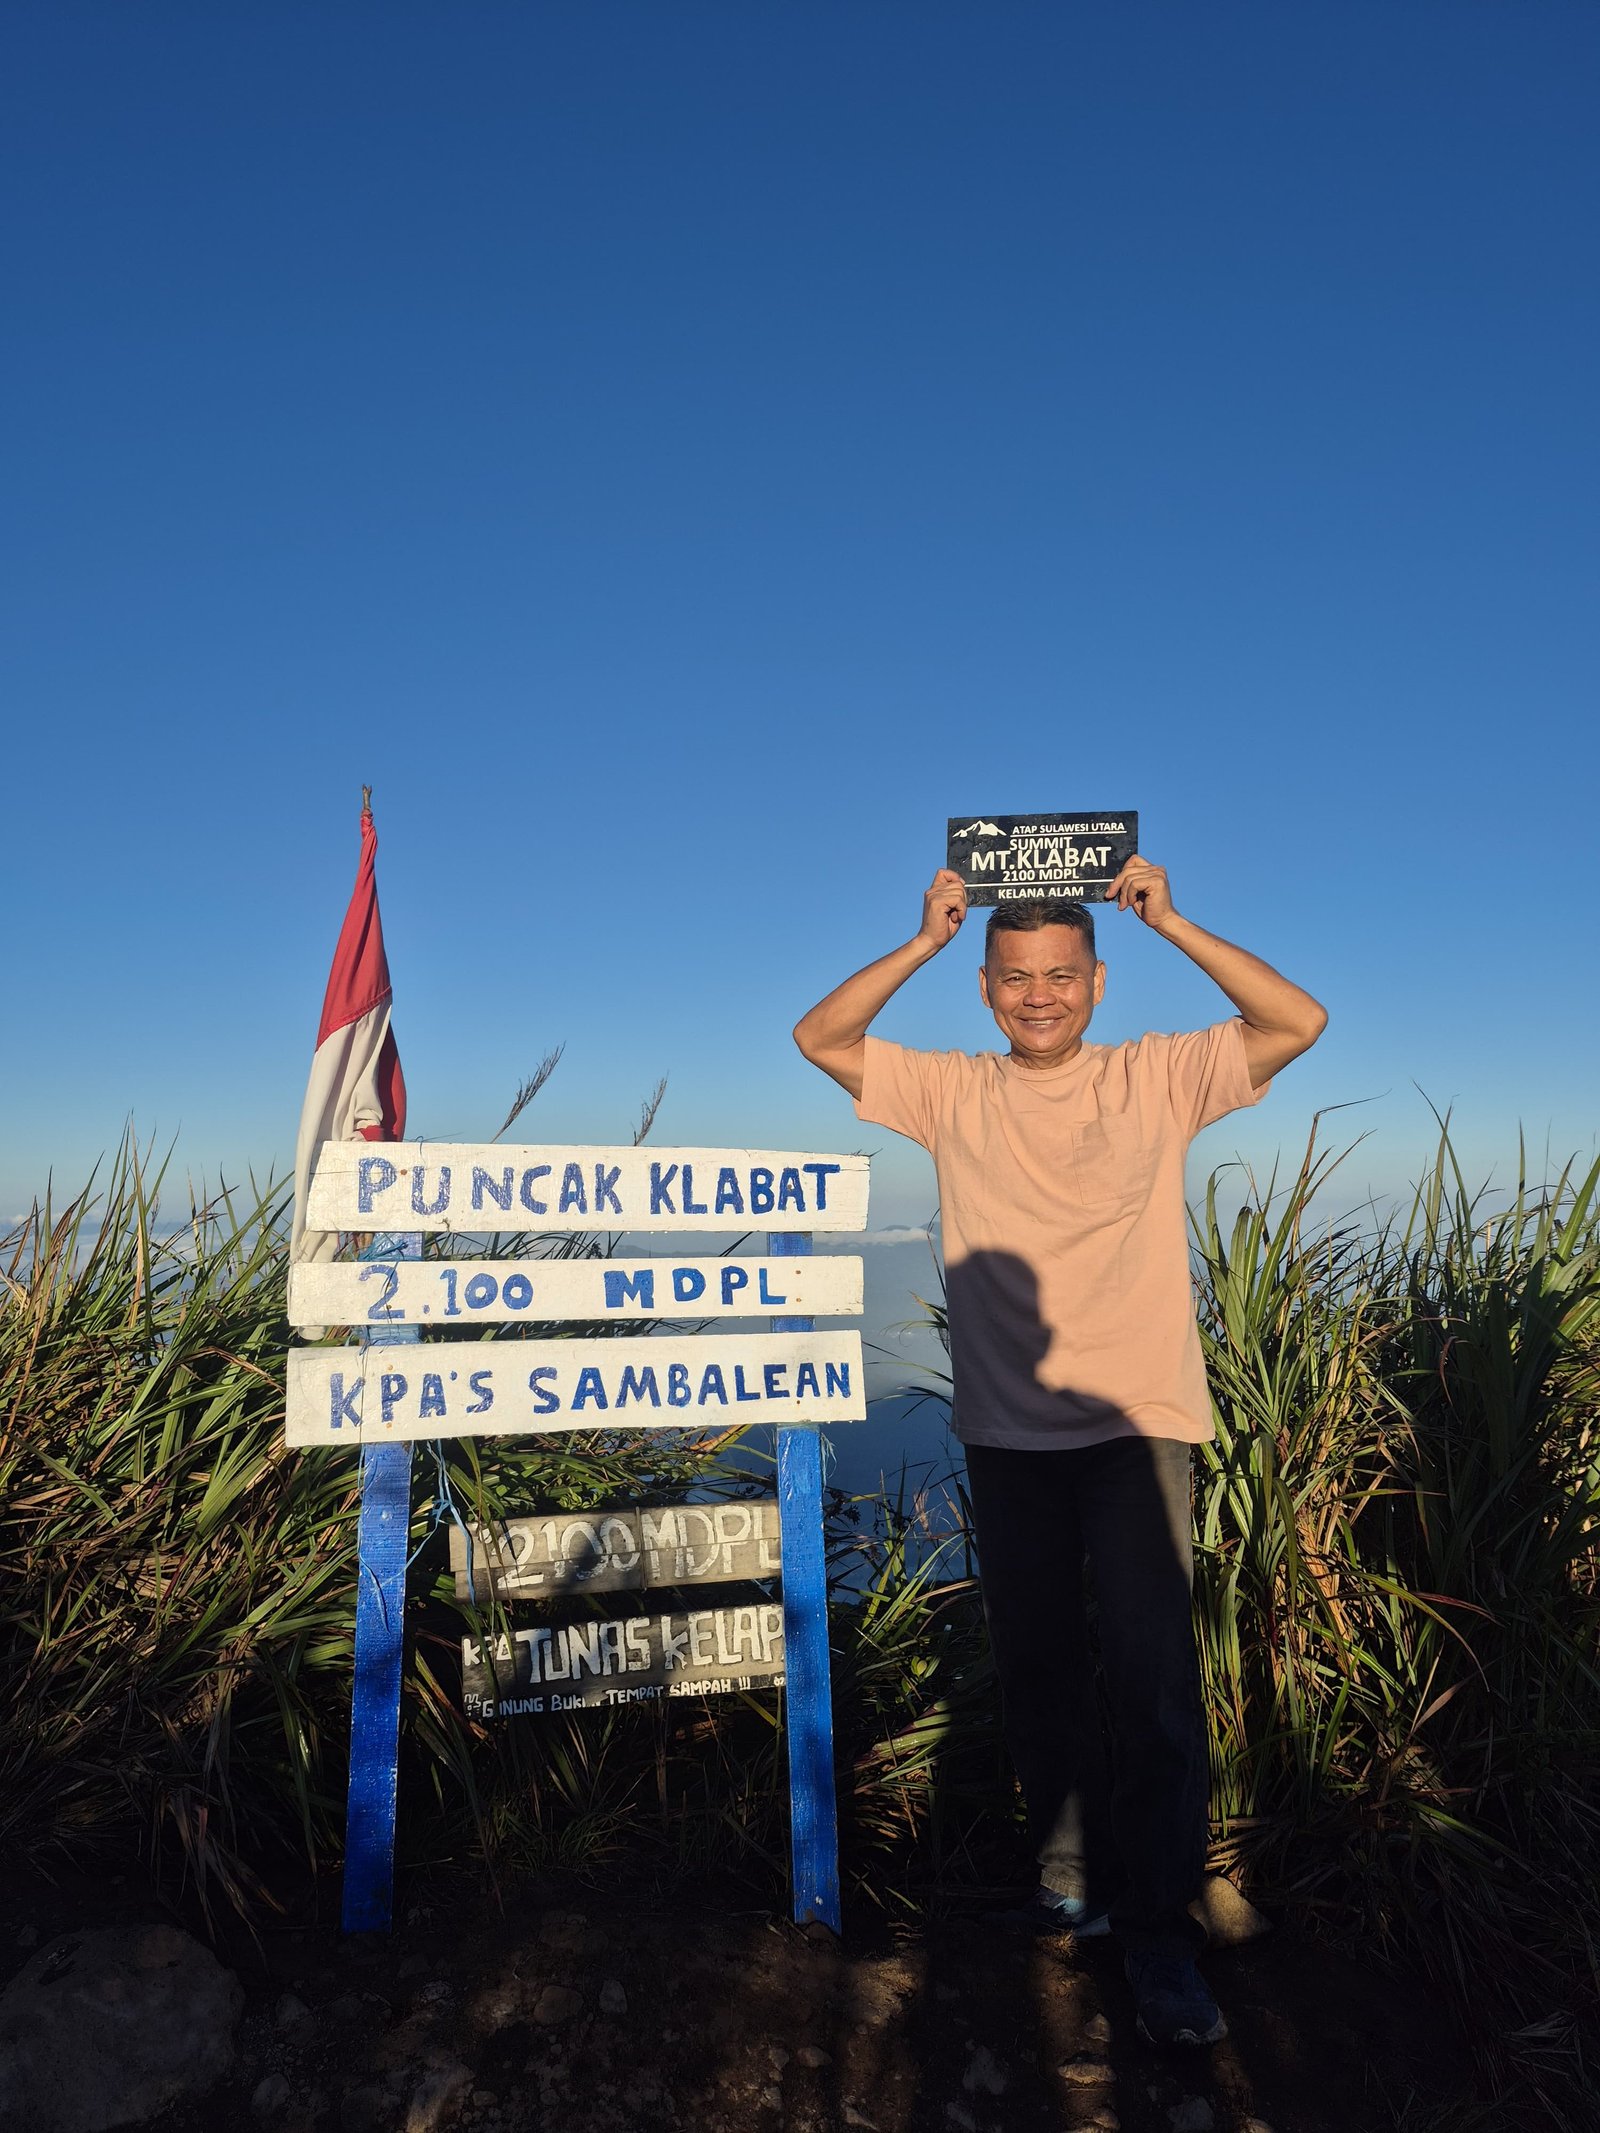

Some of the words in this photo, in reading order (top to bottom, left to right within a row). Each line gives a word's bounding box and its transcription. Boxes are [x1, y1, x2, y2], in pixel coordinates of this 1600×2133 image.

[1012, 825, 1037, 835] ATAP
[1039, 823, 1089, 834] SULAWESI
[1091, 822, 1125, 832] UTARA
[1009, 836, 1073, 851] SUMMIT
[971, 846, 1112, 871] MT.KLABAT
[1002, 869, 1037, 882] 2100
[1039, 868, 1080, 881] MDPL
[998, 887, 1046, 900] KELANA
[1048, 886, 1084, 898] ALAM
[357, 1156, 623, 1216] PUNCAK
[649, 1162, 841, 1215] KLABAT
[359, 1263, 534, 1320] 2.100
[604, 1265, 787, 1310] MDPL
[329, 1369, 494, 1430] KPA'S
[528, 1361, 851, 1415] SAMBALEAN
[491, 1516, 641, 1590] 2100
[642, 1504, 783, 1579] MDPL
[515, 1616, 652, 1684] TUNAS
[660, 1605, 785, 1671] KELAP
[605, 1684, 664, 1705] TEMPAT
[668, 1678, 732, 1697] SAMPAH
